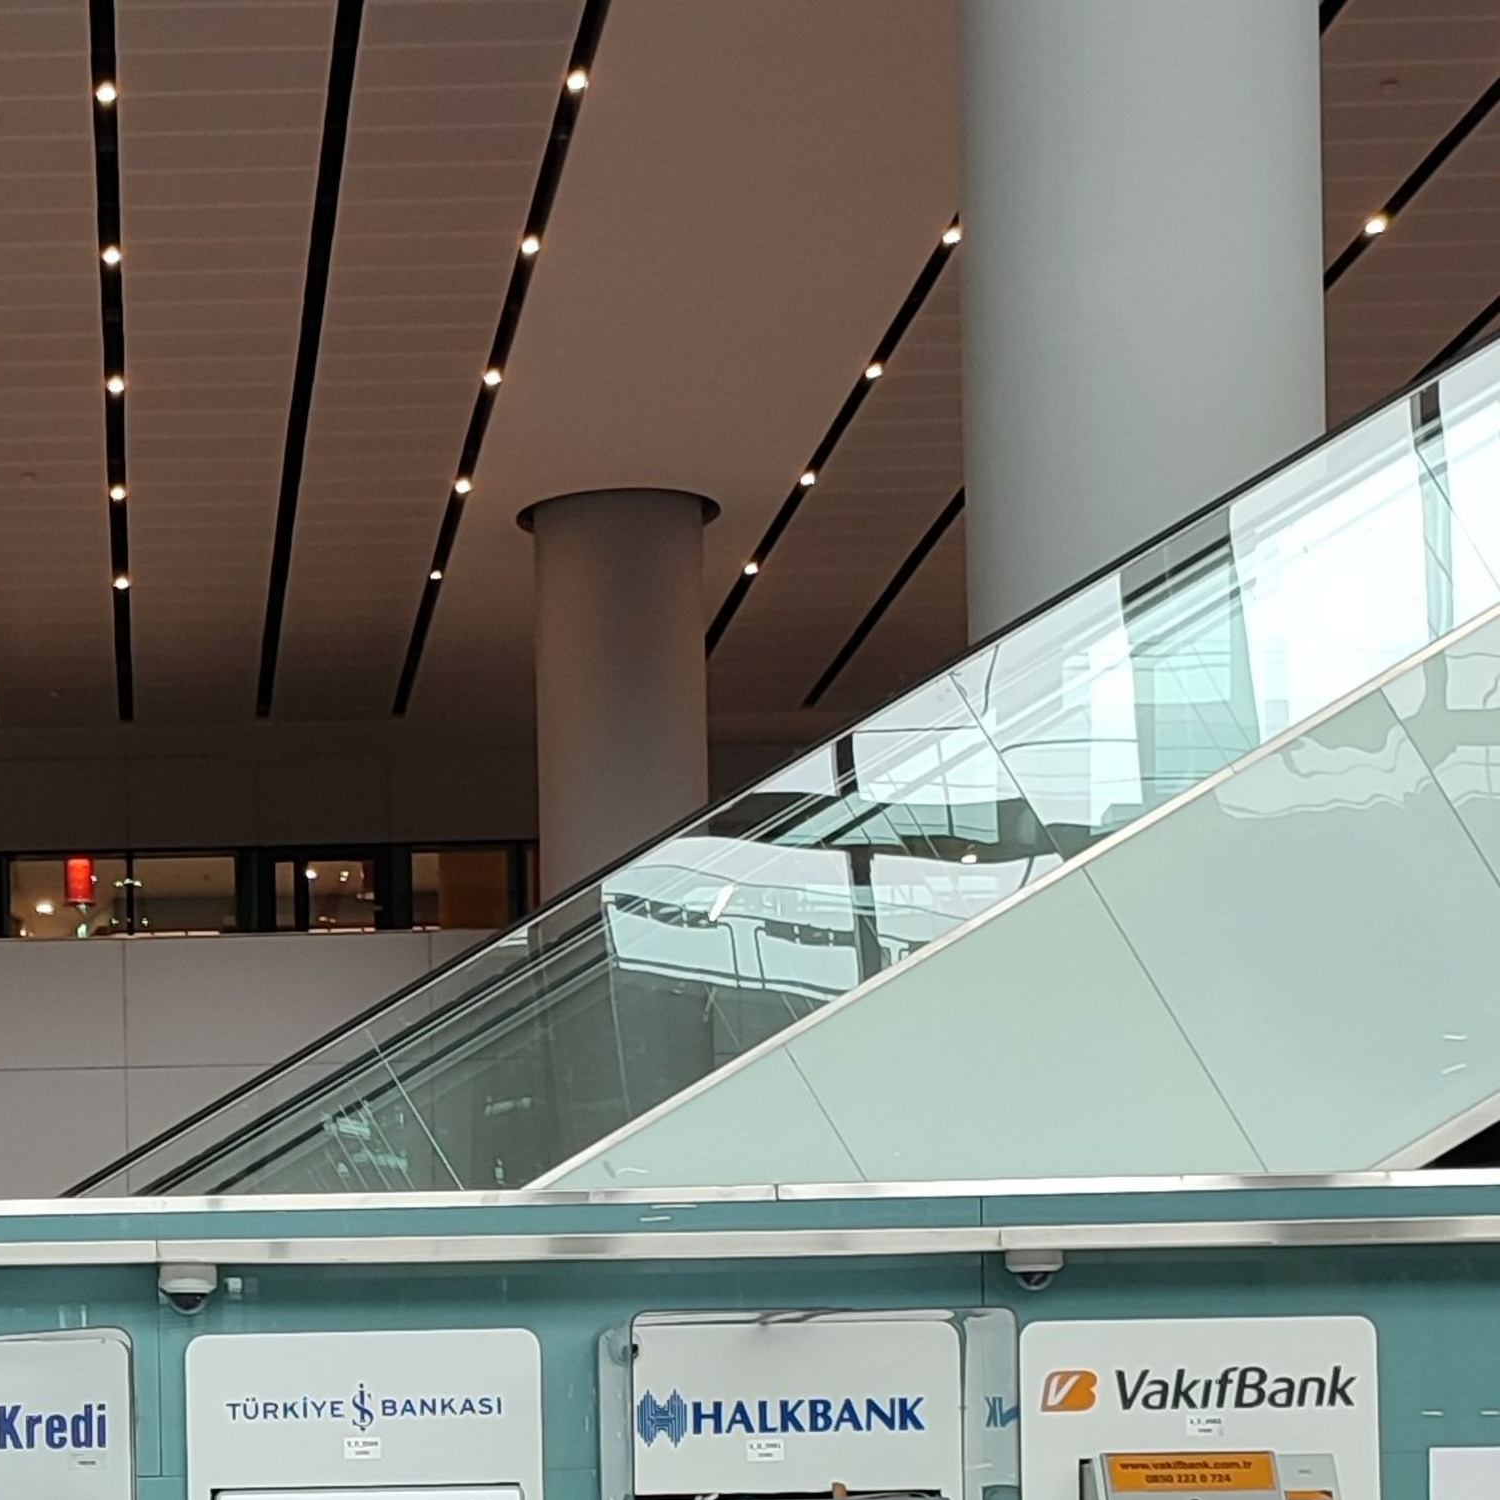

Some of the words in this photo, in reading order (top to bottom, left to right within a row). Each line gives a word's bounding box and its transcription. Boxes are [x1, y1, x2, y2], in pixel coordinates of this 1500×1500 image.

[1115, 1365, 1357, 1410] VakıfBank
[226, 1396, 345, 1421] TÜRKİYE
[381, 1396, 502, 1416] BANKASI
[692, 1396, 925, 1435] HALKBANK
